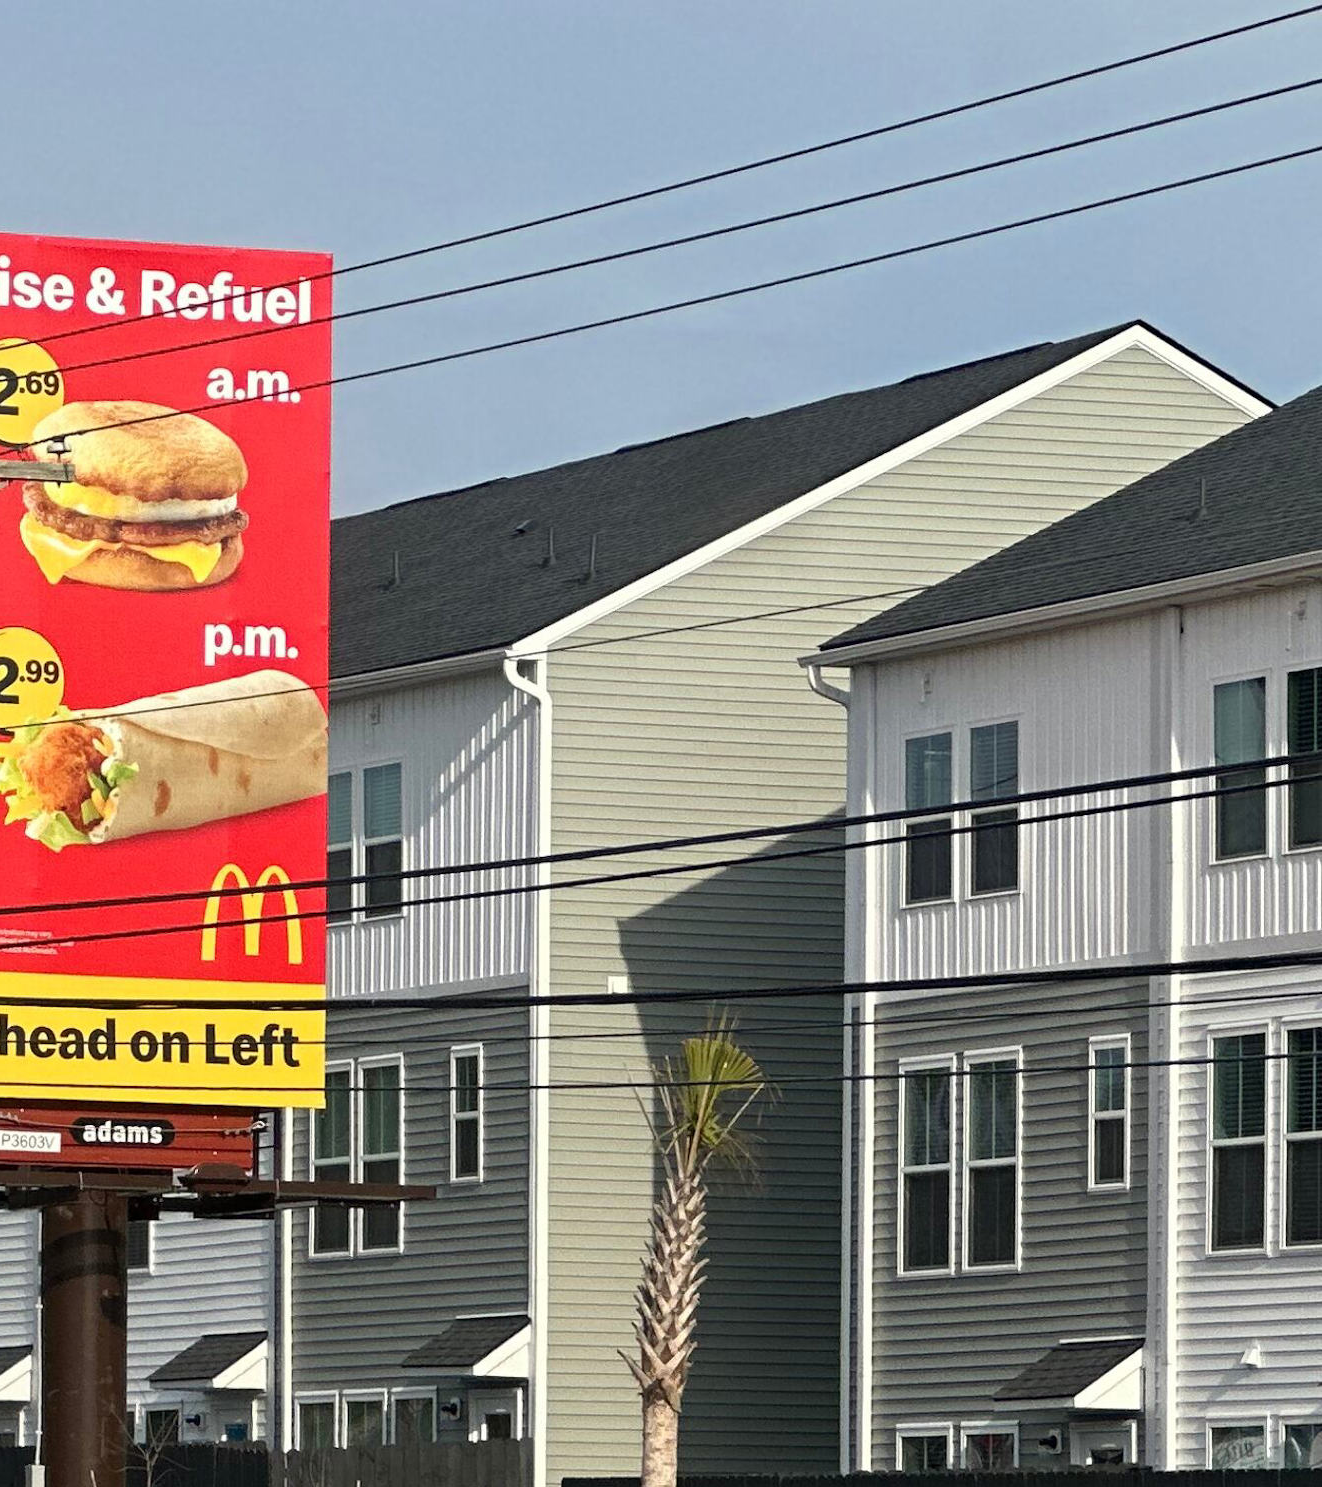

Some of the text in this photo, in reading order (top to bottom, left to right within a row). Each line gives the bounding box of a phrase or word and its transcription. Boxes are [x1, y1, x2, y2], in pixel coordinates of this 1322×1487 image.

[86, 267, 125, 315] &
[140, 269, 312, 324] Refuel
[207, 367, 301, 403] a.m.
[204, 622, 299, 666] p.m.
[130, 1030, 190, 1063] on
[206, 1023, 300, 1067] Left
[1, 1133, 55, 1149] P3603V
[82, 1121, 163, 1144] adams
